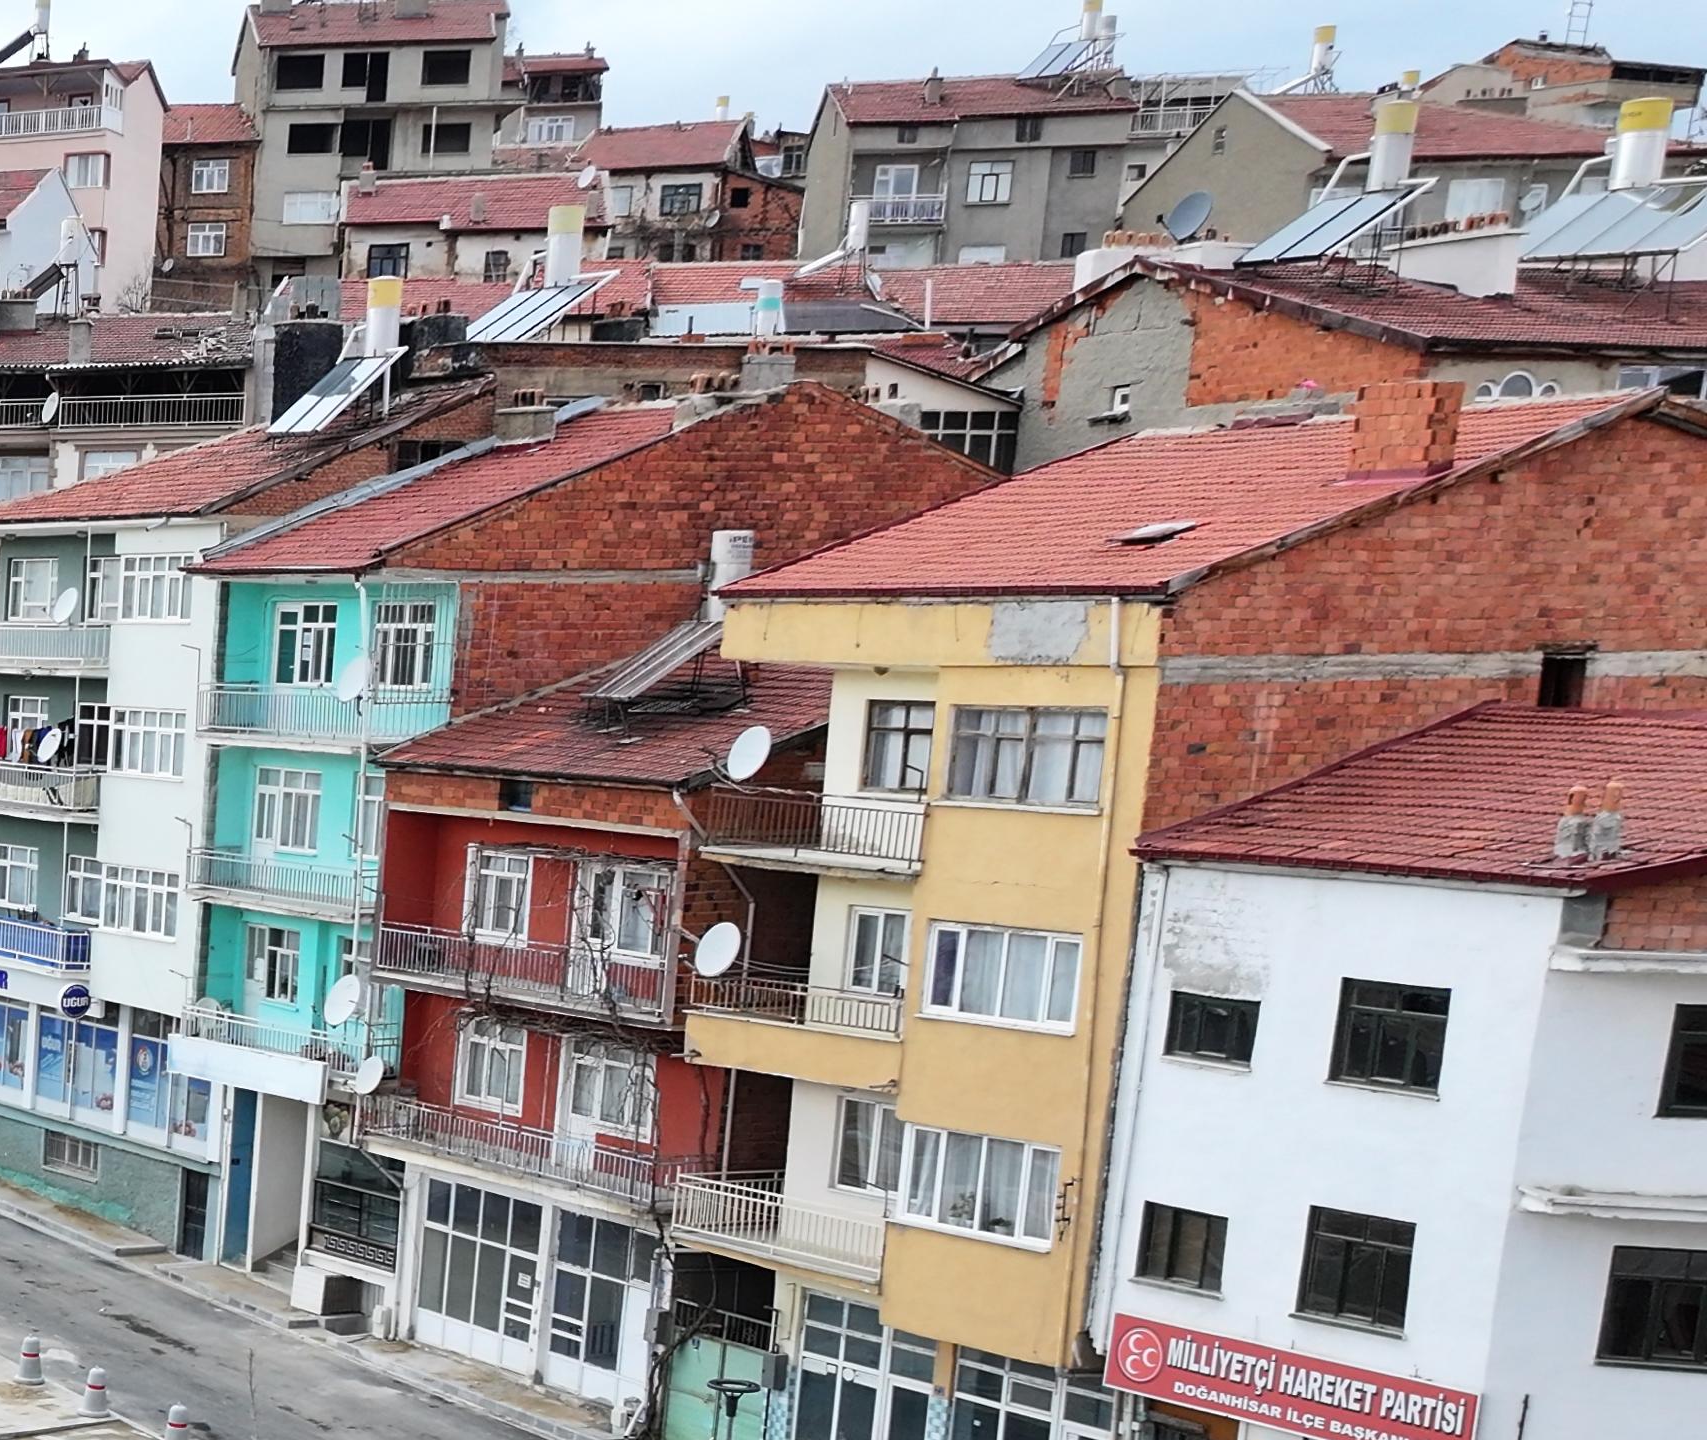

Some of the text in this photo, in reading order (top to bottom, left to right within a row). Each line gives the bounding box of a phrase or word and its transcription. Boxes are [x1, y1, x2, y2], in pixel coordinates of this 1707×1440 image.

[1167, 1335, 1467, 1437] MİLLİYETÇİ HAREKET PARTİSİ
[1173, 1380, 1282, 1419] DOĞANHİSAR
[1286, 1406, 1326, 1430] İLÇE
